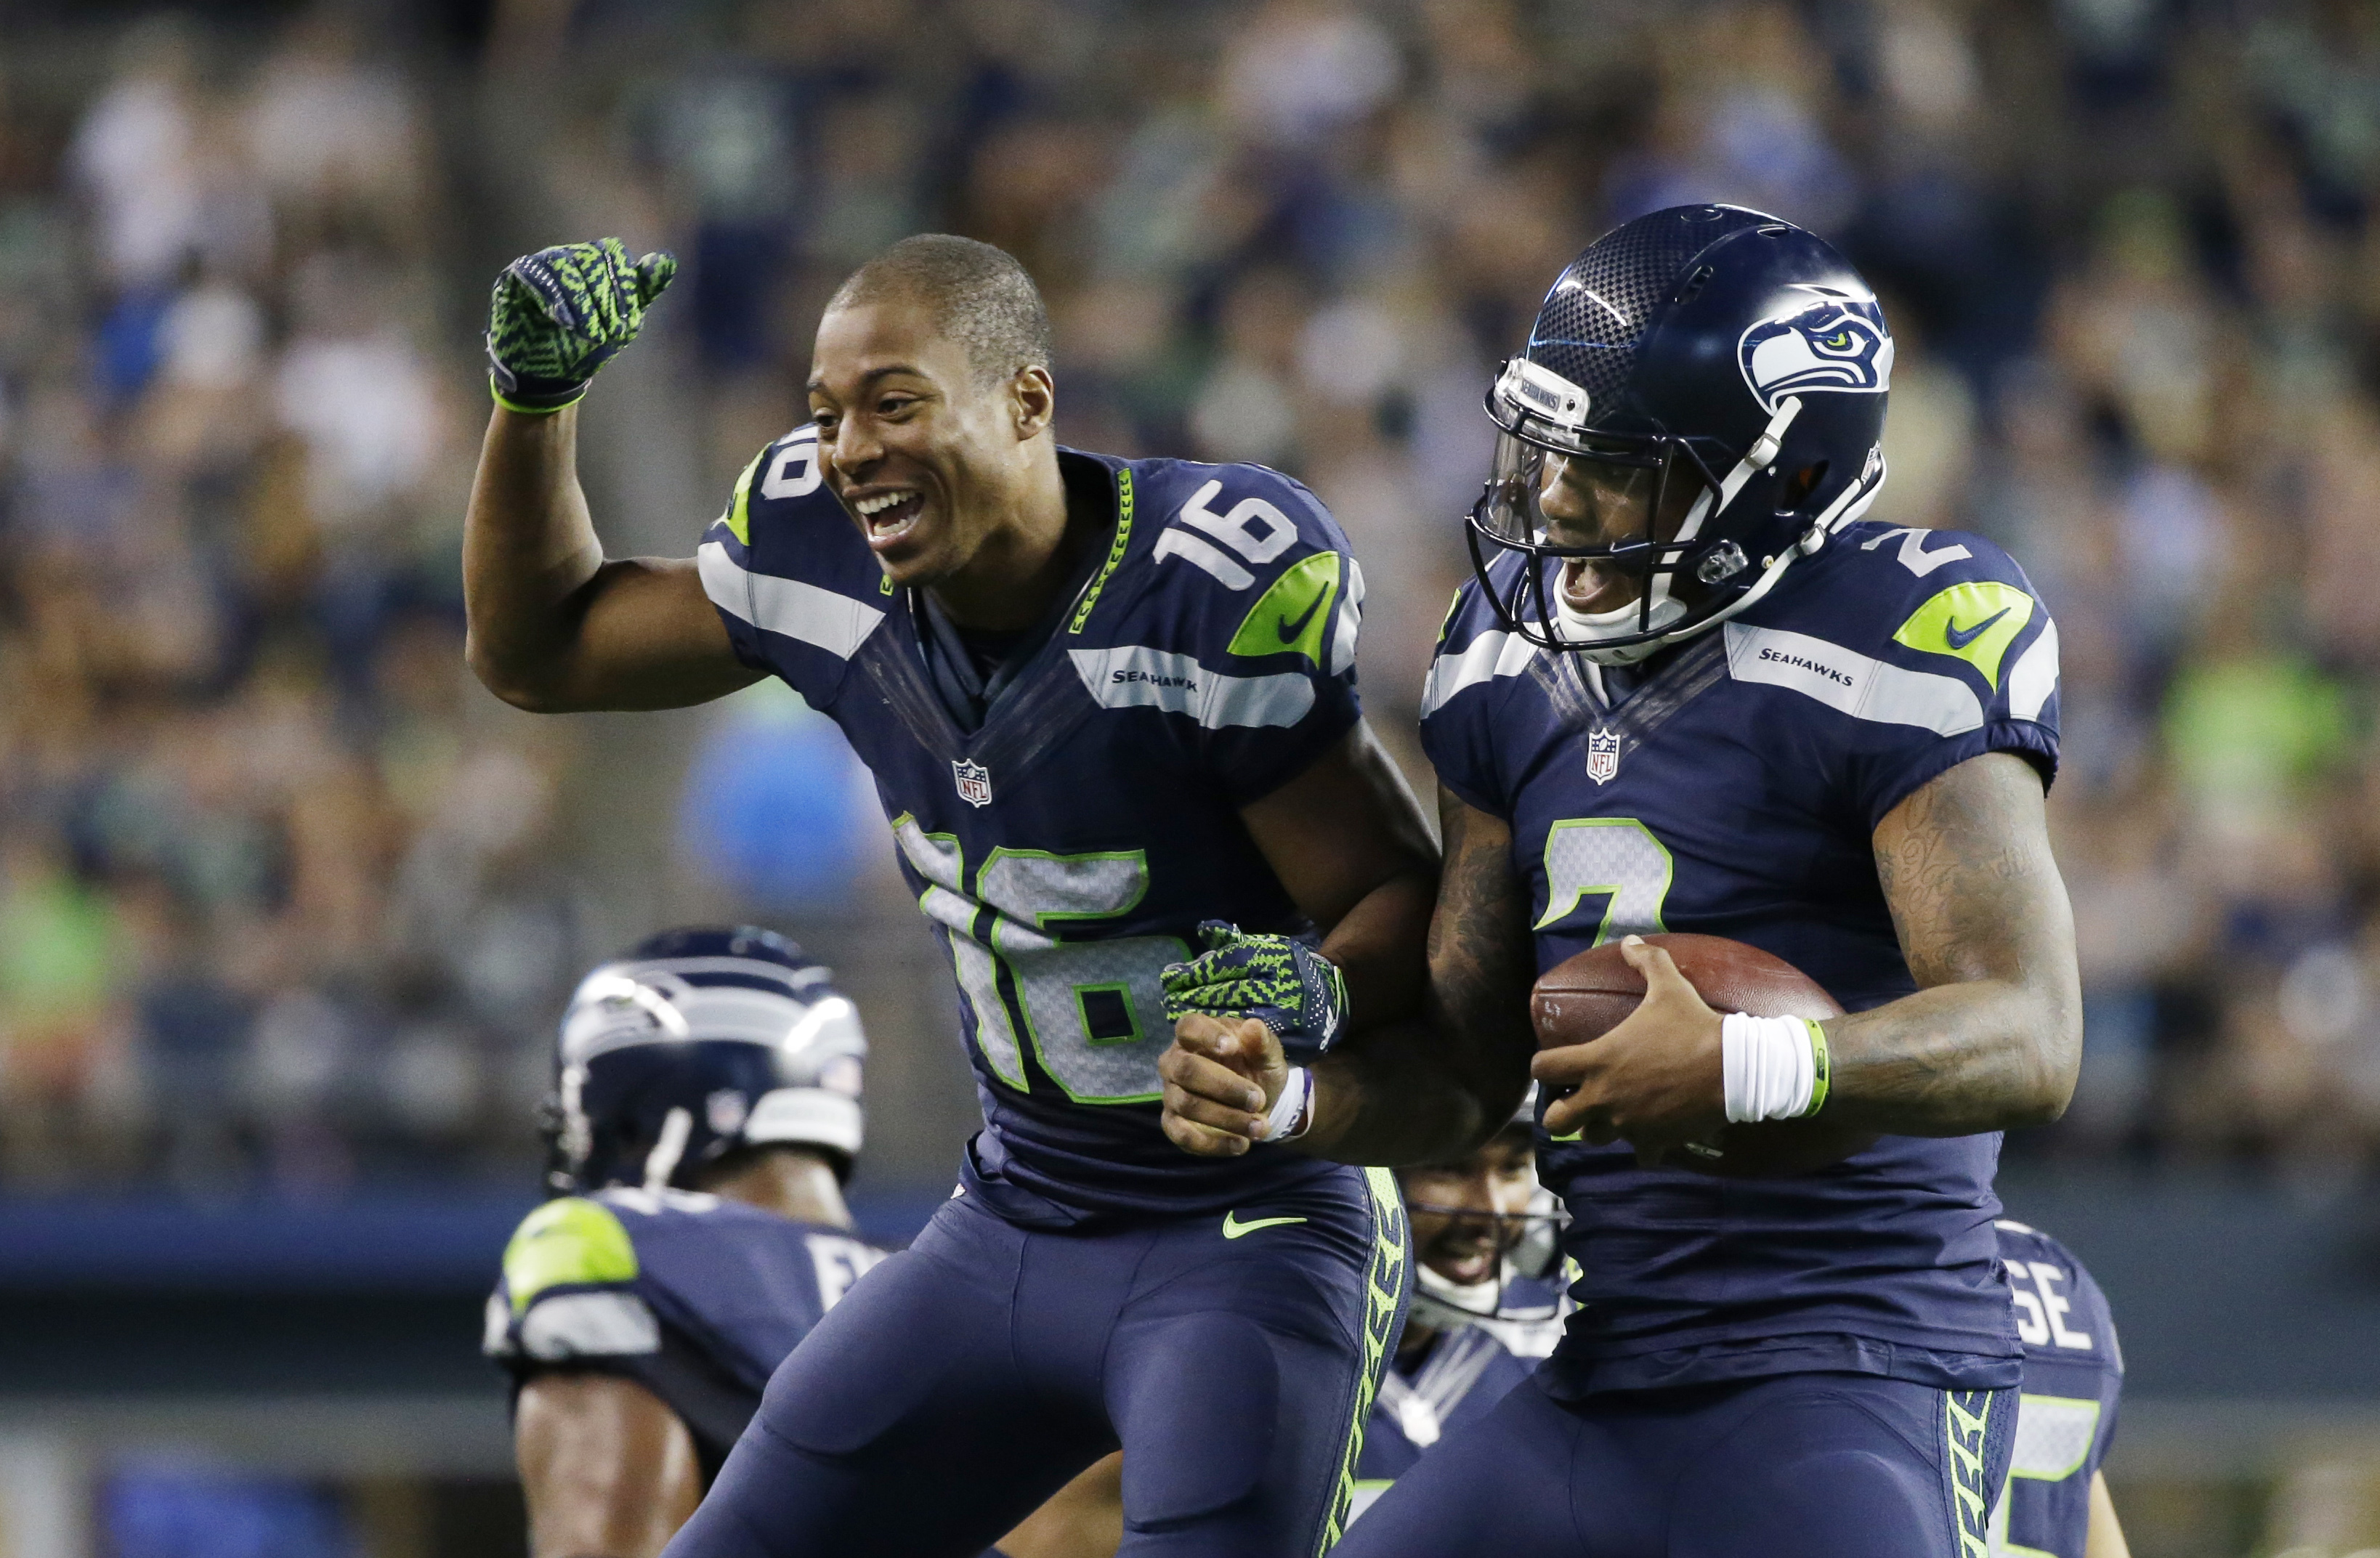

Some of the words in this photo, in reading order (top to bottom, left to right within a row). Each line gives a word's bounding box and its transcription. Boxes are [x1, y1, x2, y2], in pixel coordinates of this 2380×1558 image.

[1152, 479, 1299, 591] 16
[1861, 528, 1973, 577] 2
[1758, 648, 1854, 686] SEAHAWKS
[1591, 753, 1613, 775] NFL
[962, 779, 987, 799] NFL
[892, 810, 1193, 1105] 16
